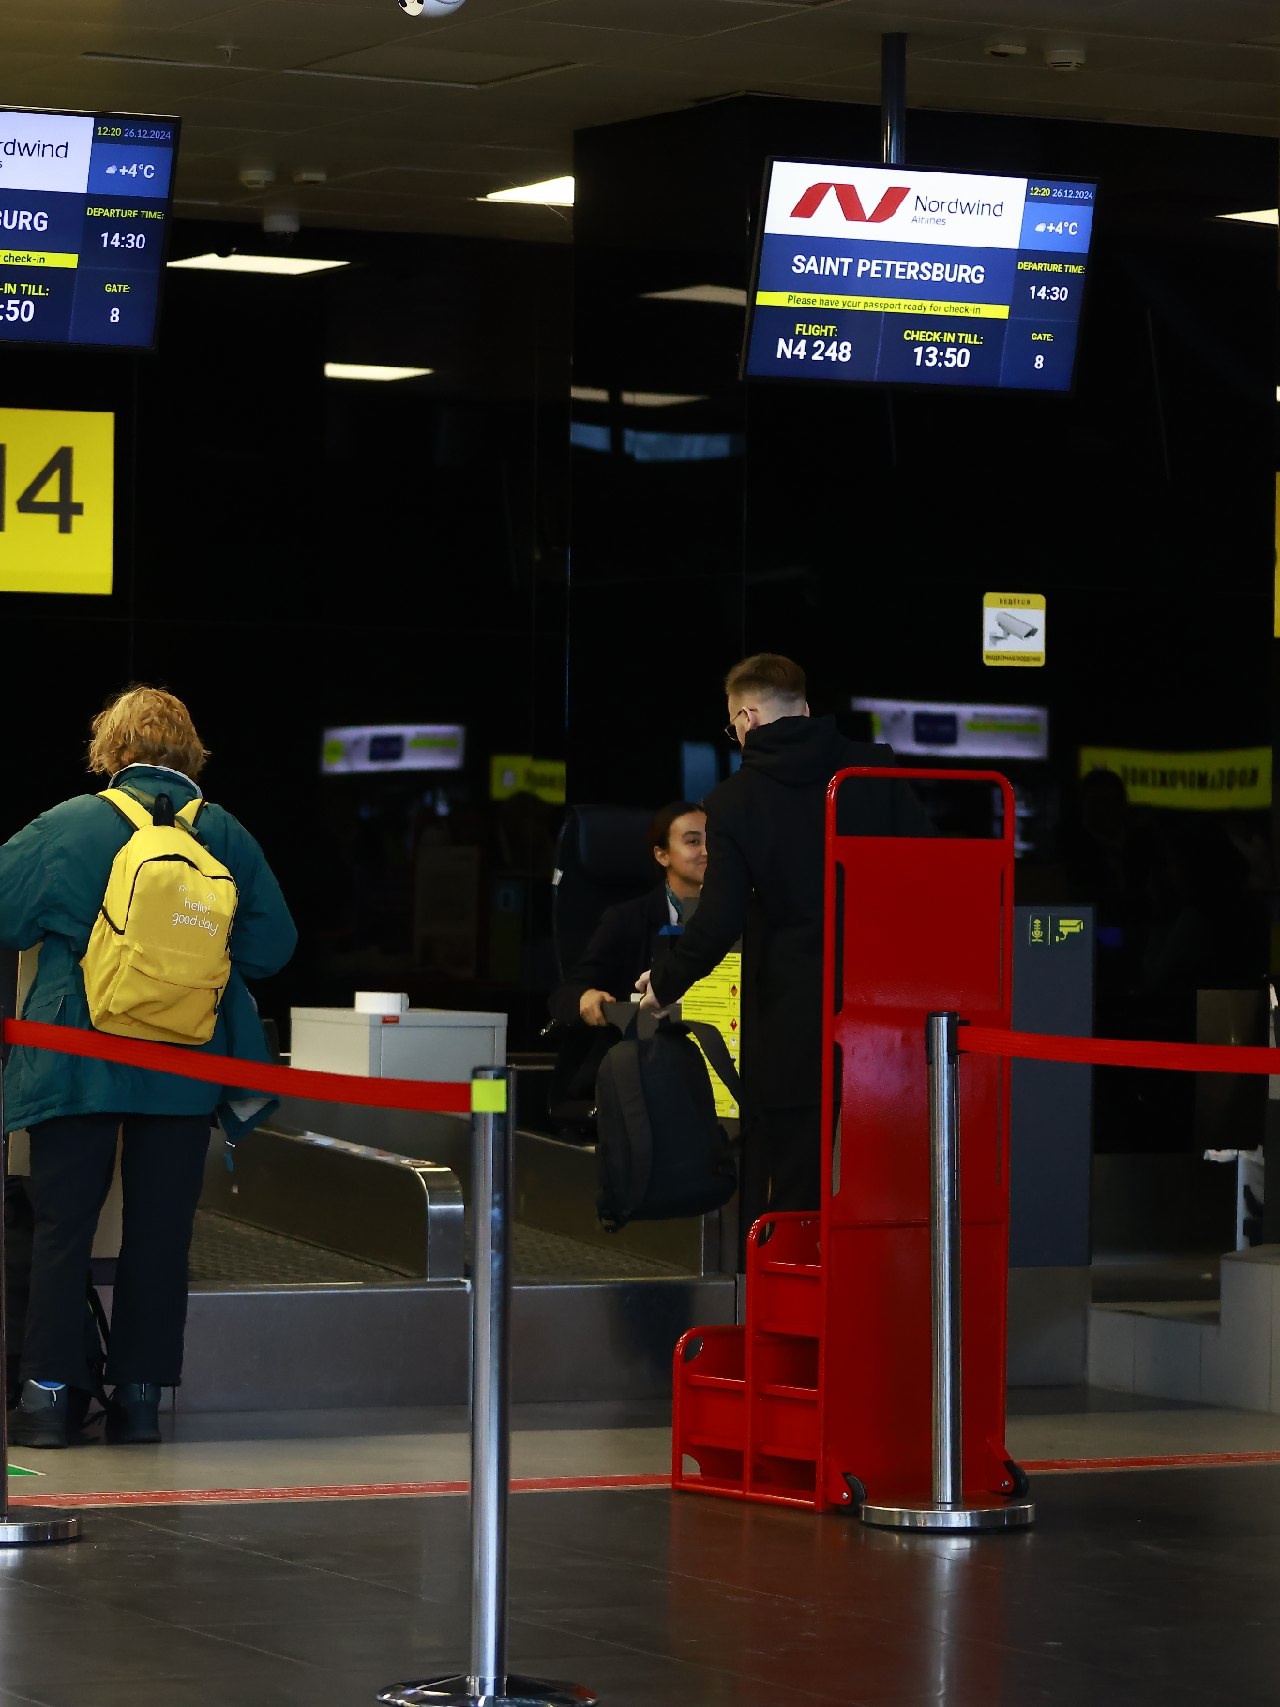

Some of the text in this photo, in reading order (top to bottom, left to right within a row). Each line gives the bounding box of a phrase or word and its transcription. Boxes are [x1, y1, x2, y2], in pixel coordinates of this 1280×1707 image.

[97, 127, 171, 139] 12:20 26.12.2024
[1030, 187, 1093, 199] 12:20 26.12.2024
[86, 207, 165, 220] DEPARTURE TIME:
[914, 195, 1003, 217] Nordwind
[100, 232, 145, 249] 14:30
[3, 253, 45, 264] check-in
[792, 254, 984, 283] SAINT PETERSBURG
[1017, 262, 1086, 274] DEPARTURE TIME:
[20, 284, 49, 296] TILL:
[105, 284, 130, 293] GATE:
[1030, 285, 1068, 301] 14:30
[788, 295, 981, 315] Please have your passport ready for check-in
[110, 308, 120, 323] 8
[795, 323, 837, 337] FLIGHT:
[904, 330, 983, 345] CHECK-IN TILL:
[1031, 333, 1054, 341] GATE:
[776, 338, 852, 362] N4 248
[913, 346, 970, 368] 13:50
[1034, 355, 1044, 369] 8
[185, 897, 210, 914] hello!
[173, 913, 218, 936] good day
